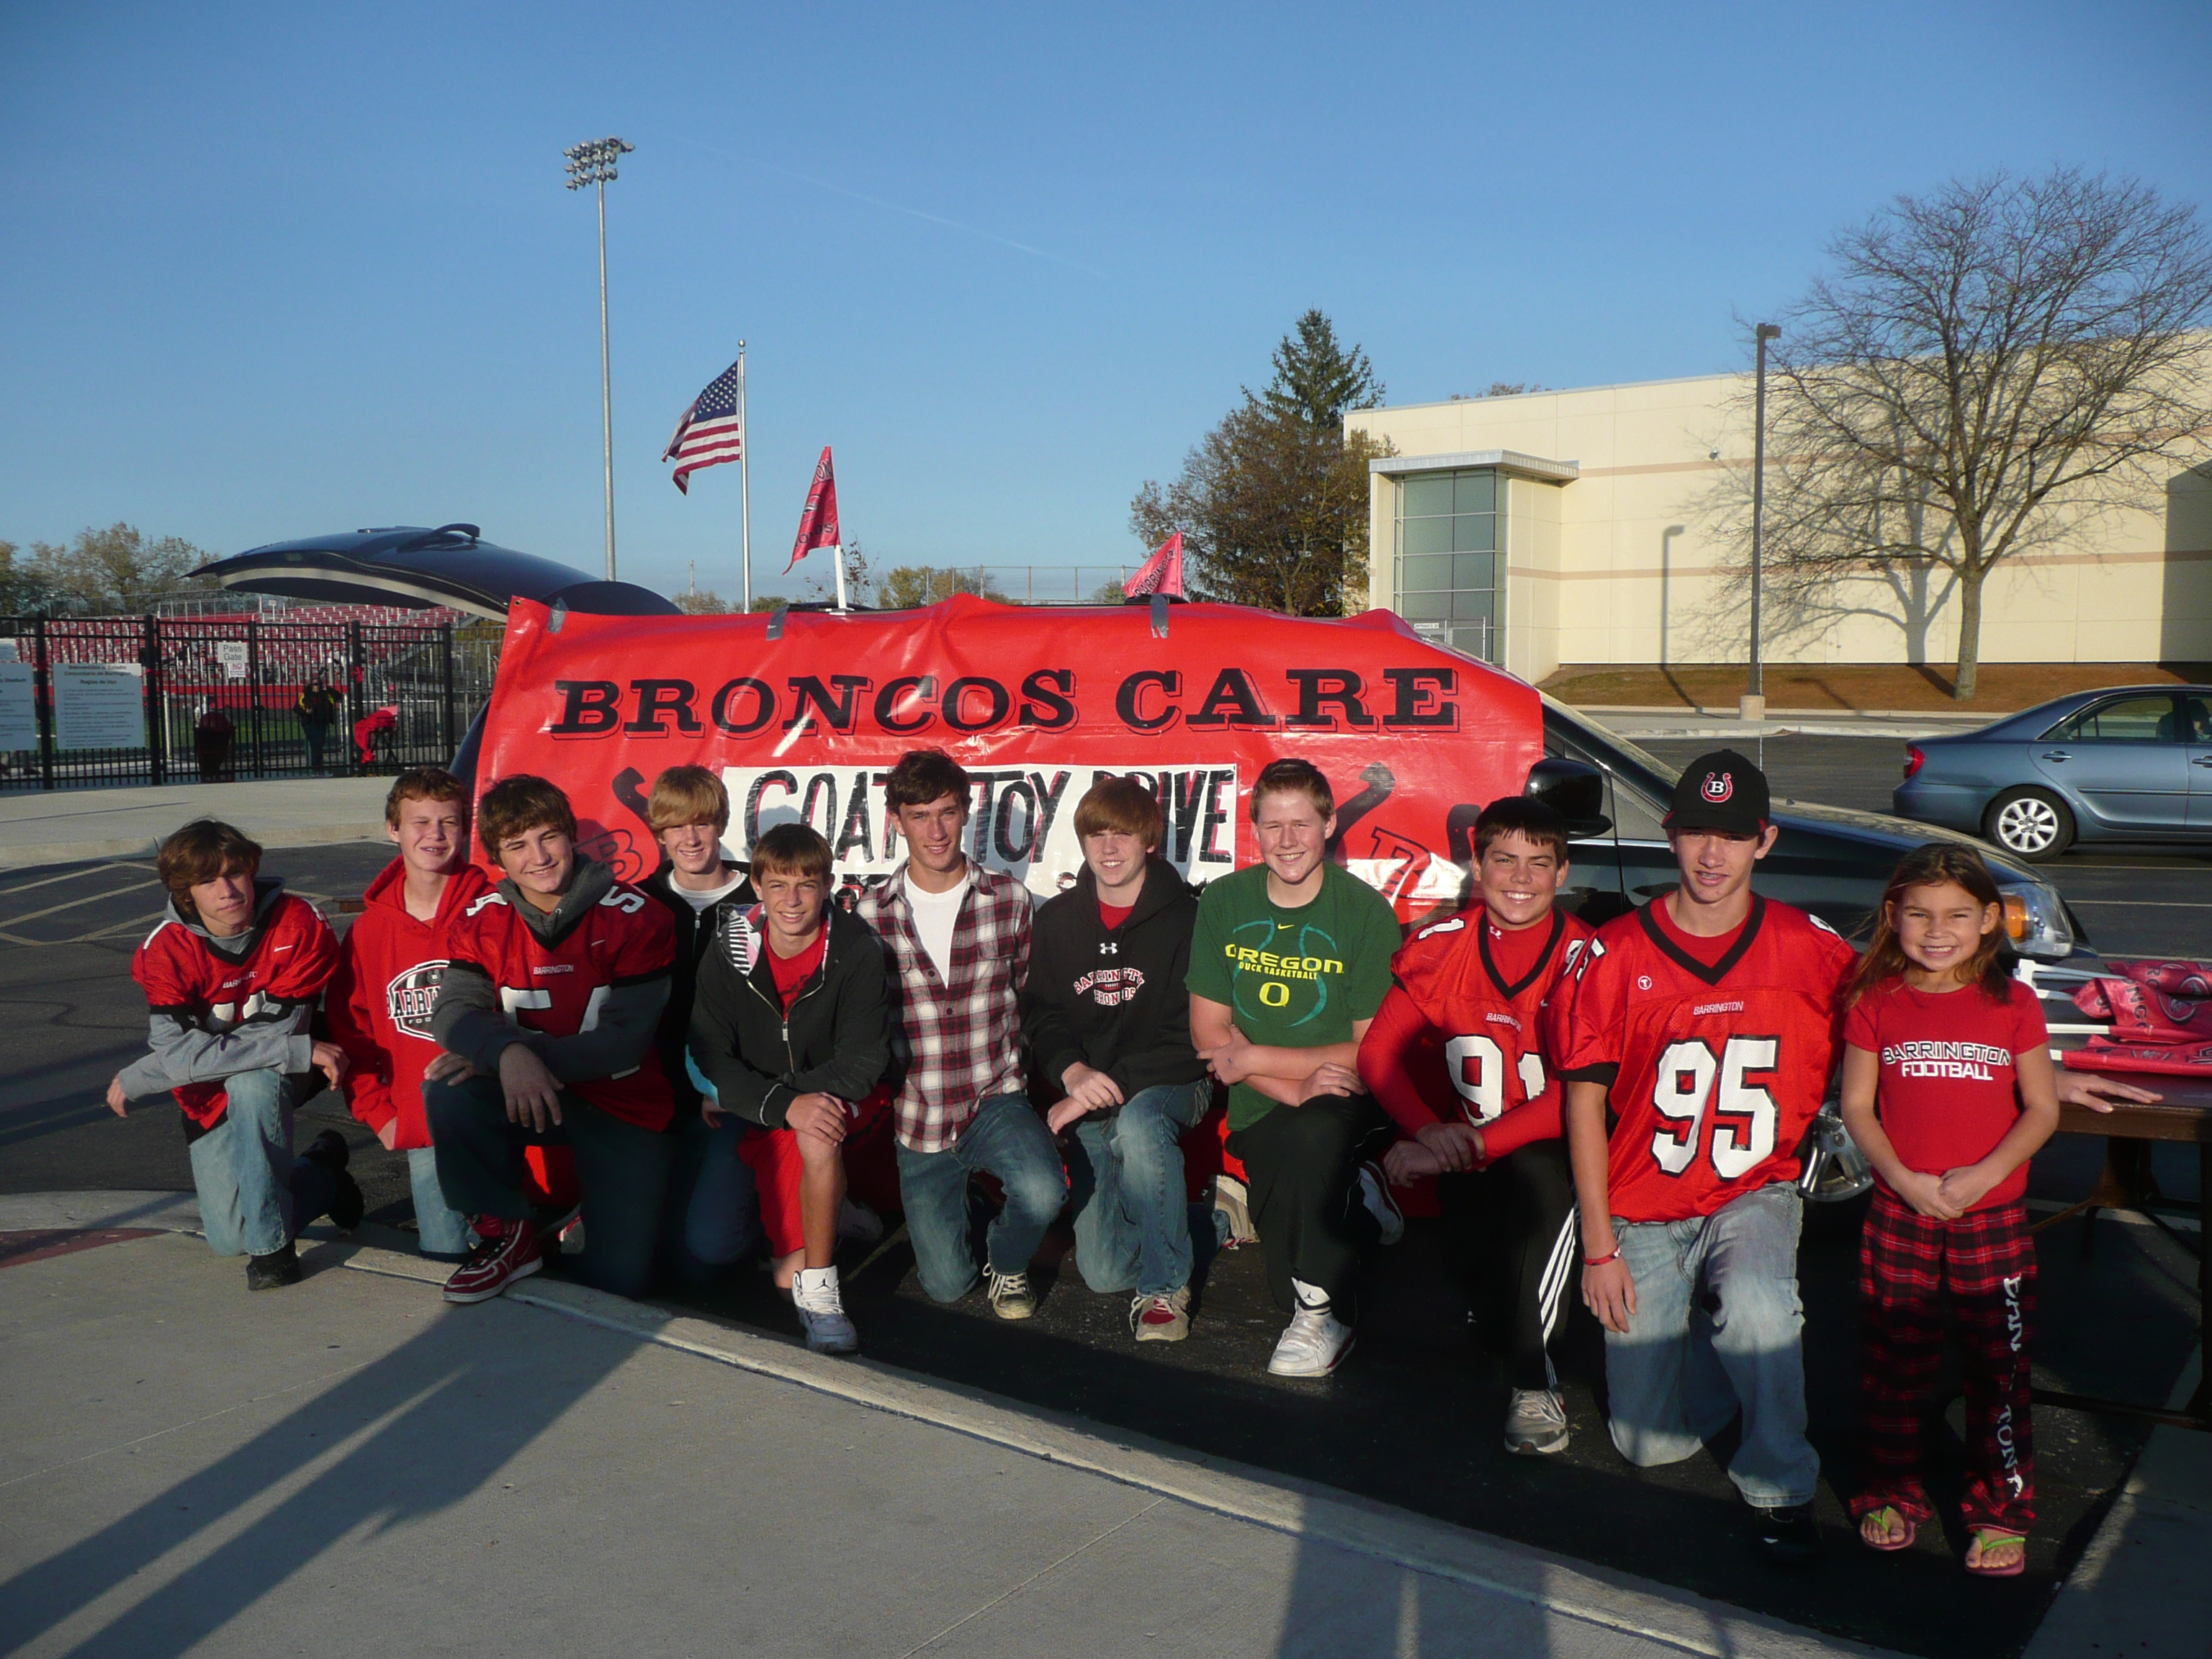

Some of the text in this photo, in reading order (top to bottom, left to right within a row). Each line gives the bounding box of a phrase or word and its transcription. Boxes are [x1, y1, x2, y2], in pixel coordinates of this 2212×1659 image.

[224, 652, 242, 661] Gate
[549, 667, 1460, 740] BRONCOS CARE
[1708, 781, 1725, 793] B
[968, 770, 1072, 863] TOY
[1091, 769, 1235, 864] IVE
[1225, 943, 1344, 974] OREGON
[533, 964, 574, 975] BARRINGTON
[1238, 961, 1318, 980] DUCK BASKETBALL
[1093, 987, 1136, 1006] BRONOS
[1259, 981, 1290, 1007] O
[1694, 1001, 1744, 1016] BARRINGTON
[1881, 1040, 2012, 1066] BARRINGTON
[1902, 1060, 1994, 1081] FOOTBALL
[1650, 1033, 1781, 1183] 95
